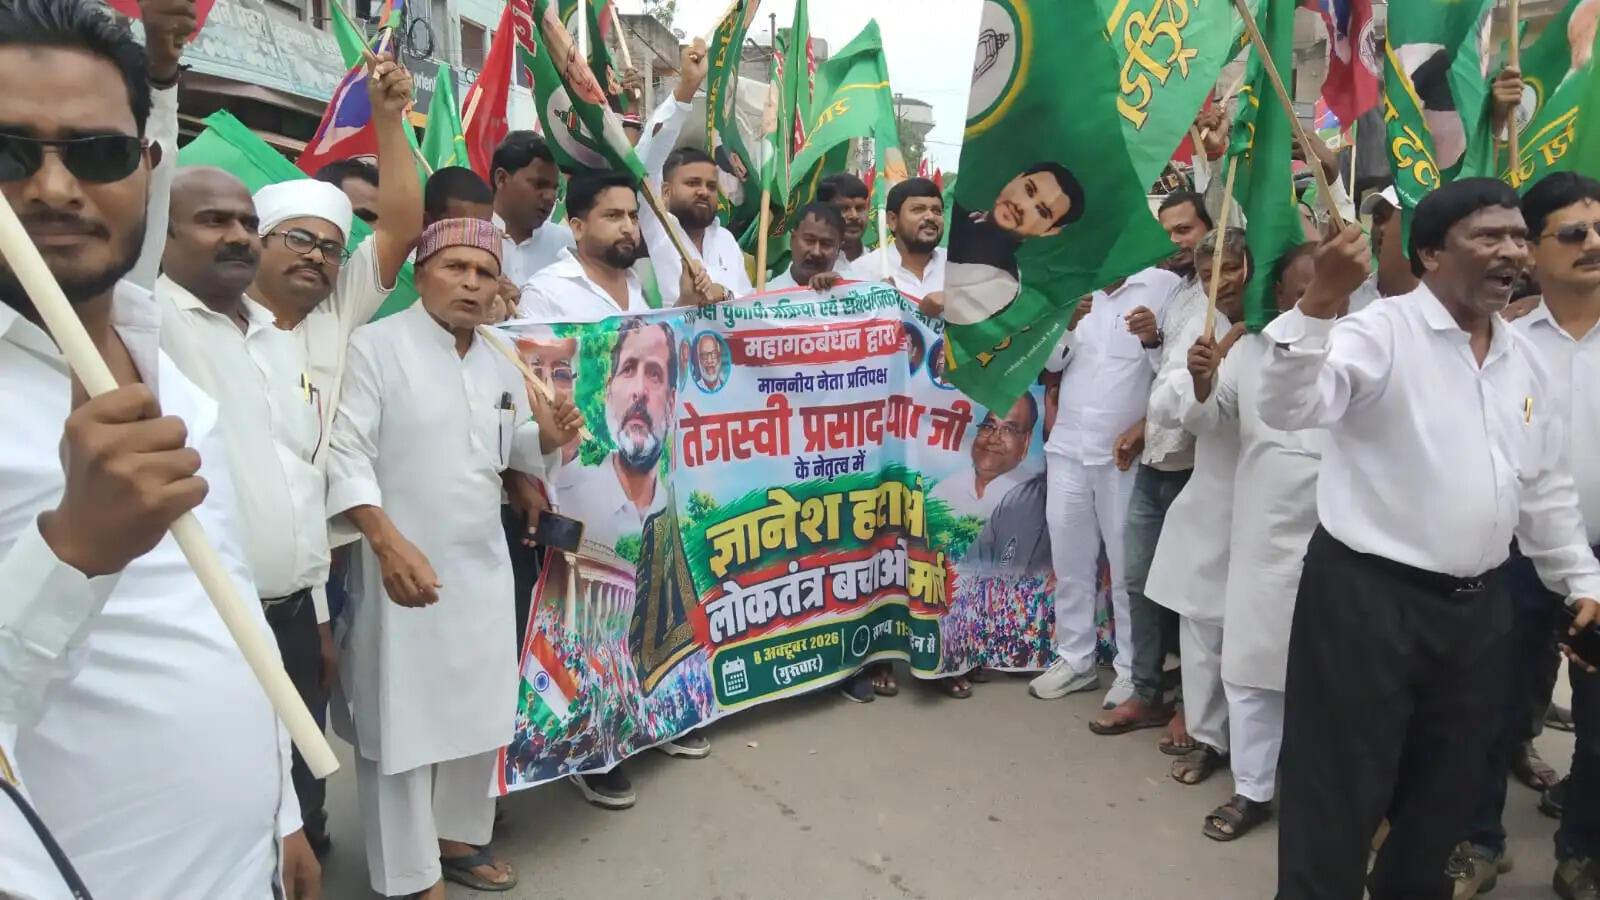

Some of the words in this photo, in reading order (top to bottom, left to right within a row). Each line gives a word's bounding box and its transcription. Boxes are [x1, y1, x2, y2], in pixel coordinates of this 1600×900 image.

[817, 294, 840, 316] एवं
[744, 325, 861, 360] महागठबंधन
[865, 324, 897, 353] द्वारा
[757, 371, 815, 393] माननीय
[817, 370, 843, 391] नेता
[847, 366, 888, 389] प्रतिपक्ष
[679, 394, 793, 468] तेजस्वी
[800, 399, 886, 453] प्रसाद
[927, 399, 973, 452] जी
[794, 455, 809, 480] के
[812, 454, 850, 482] नेतृत्व
[852, 450, 867, 472] में
[706, 488, 843, 579] ज्ञानेश
[705, 560, 826, 643] लोकतंत्र
[829, 537, 909, 601] बचाओ
[763, 638, 808, 661] अक्टूबर
[810, 631, 839, 649] 2026
[772, 653, 823, 685] (गुरुवार)
